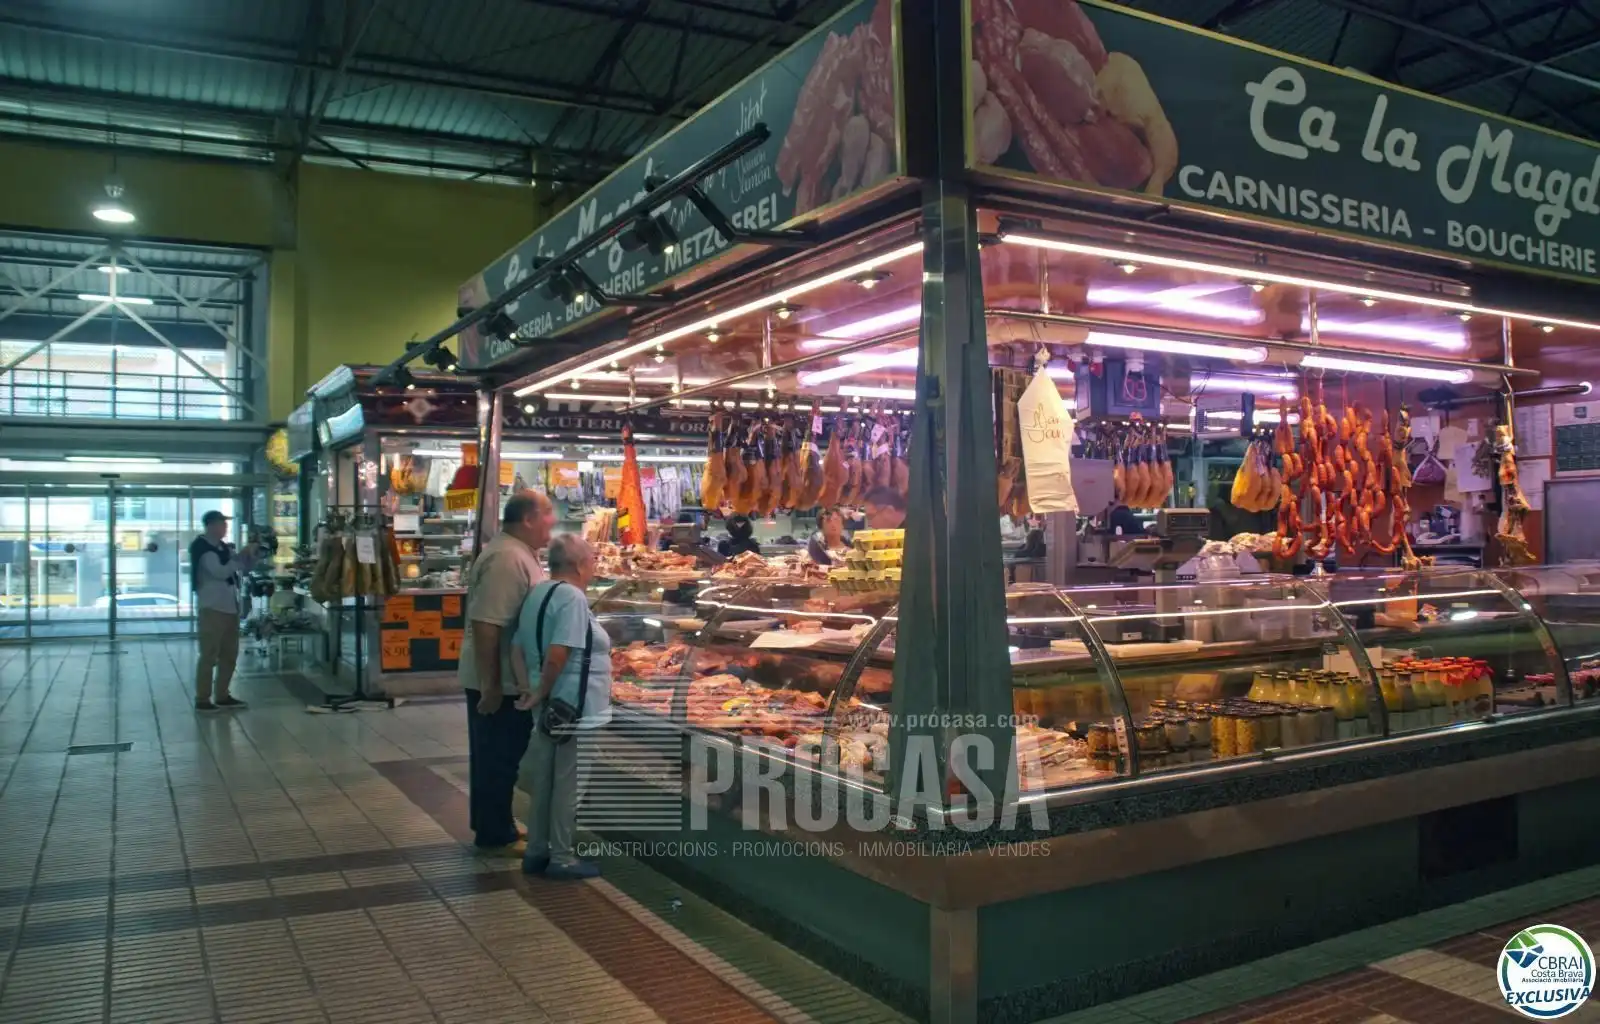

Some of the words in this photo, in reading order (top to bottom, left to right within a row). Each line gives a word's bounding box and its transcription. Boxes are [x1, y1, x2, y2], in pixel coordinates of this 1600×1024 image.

[1245, 66, 1341, 160] Ca
[1361, 94, 1422, 172] la
[1178, 165, 1413, 239] CARNISSERIA
[1447, 220, 1597, 274] BOUCHERIE
[565, 261, 645, 322] BOUHERIE
